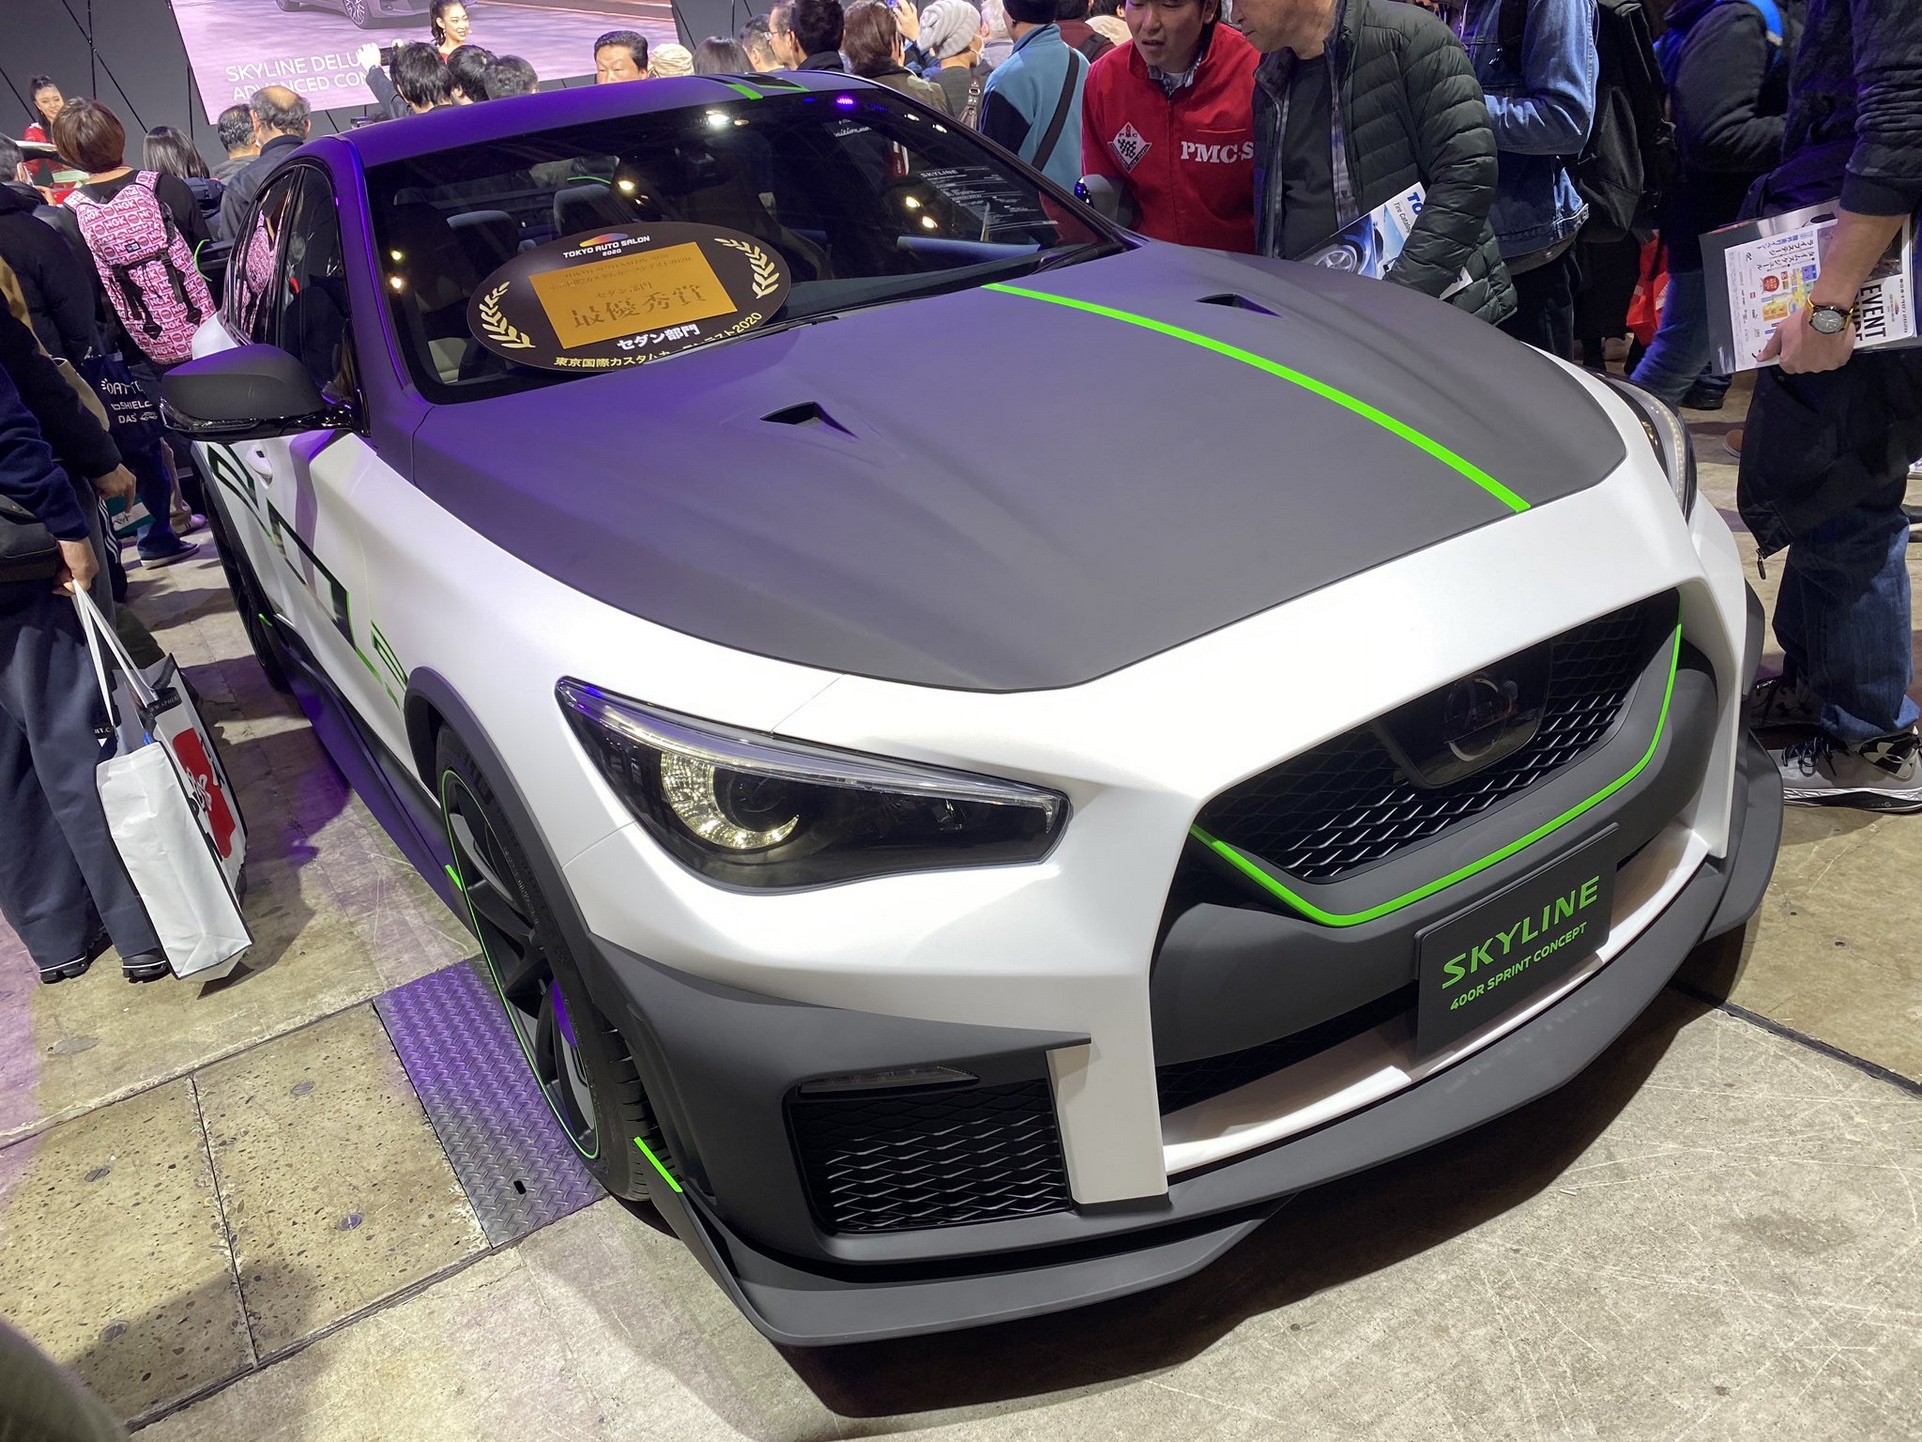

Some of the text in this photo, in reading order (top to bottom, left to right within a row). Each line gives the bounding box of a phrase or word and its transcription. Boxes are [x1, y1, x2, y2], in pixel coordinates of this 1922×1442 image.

[225, 52, 363, 82] SKYLINE DELU
[563, 235, 651, 259] TOKYO AUTO SALON
[602, 248, 622, 257] 2020
[570, 284, 708, 329] 最優秀賞
[1860, 284, 1887, 338] EVENT
[617, 322, 701, 351] セダン部門
[1441, 875, 1600, 990] SKYLINE
[1450, 921, 1588, 1011] 400R SPRINT CONCEPT
